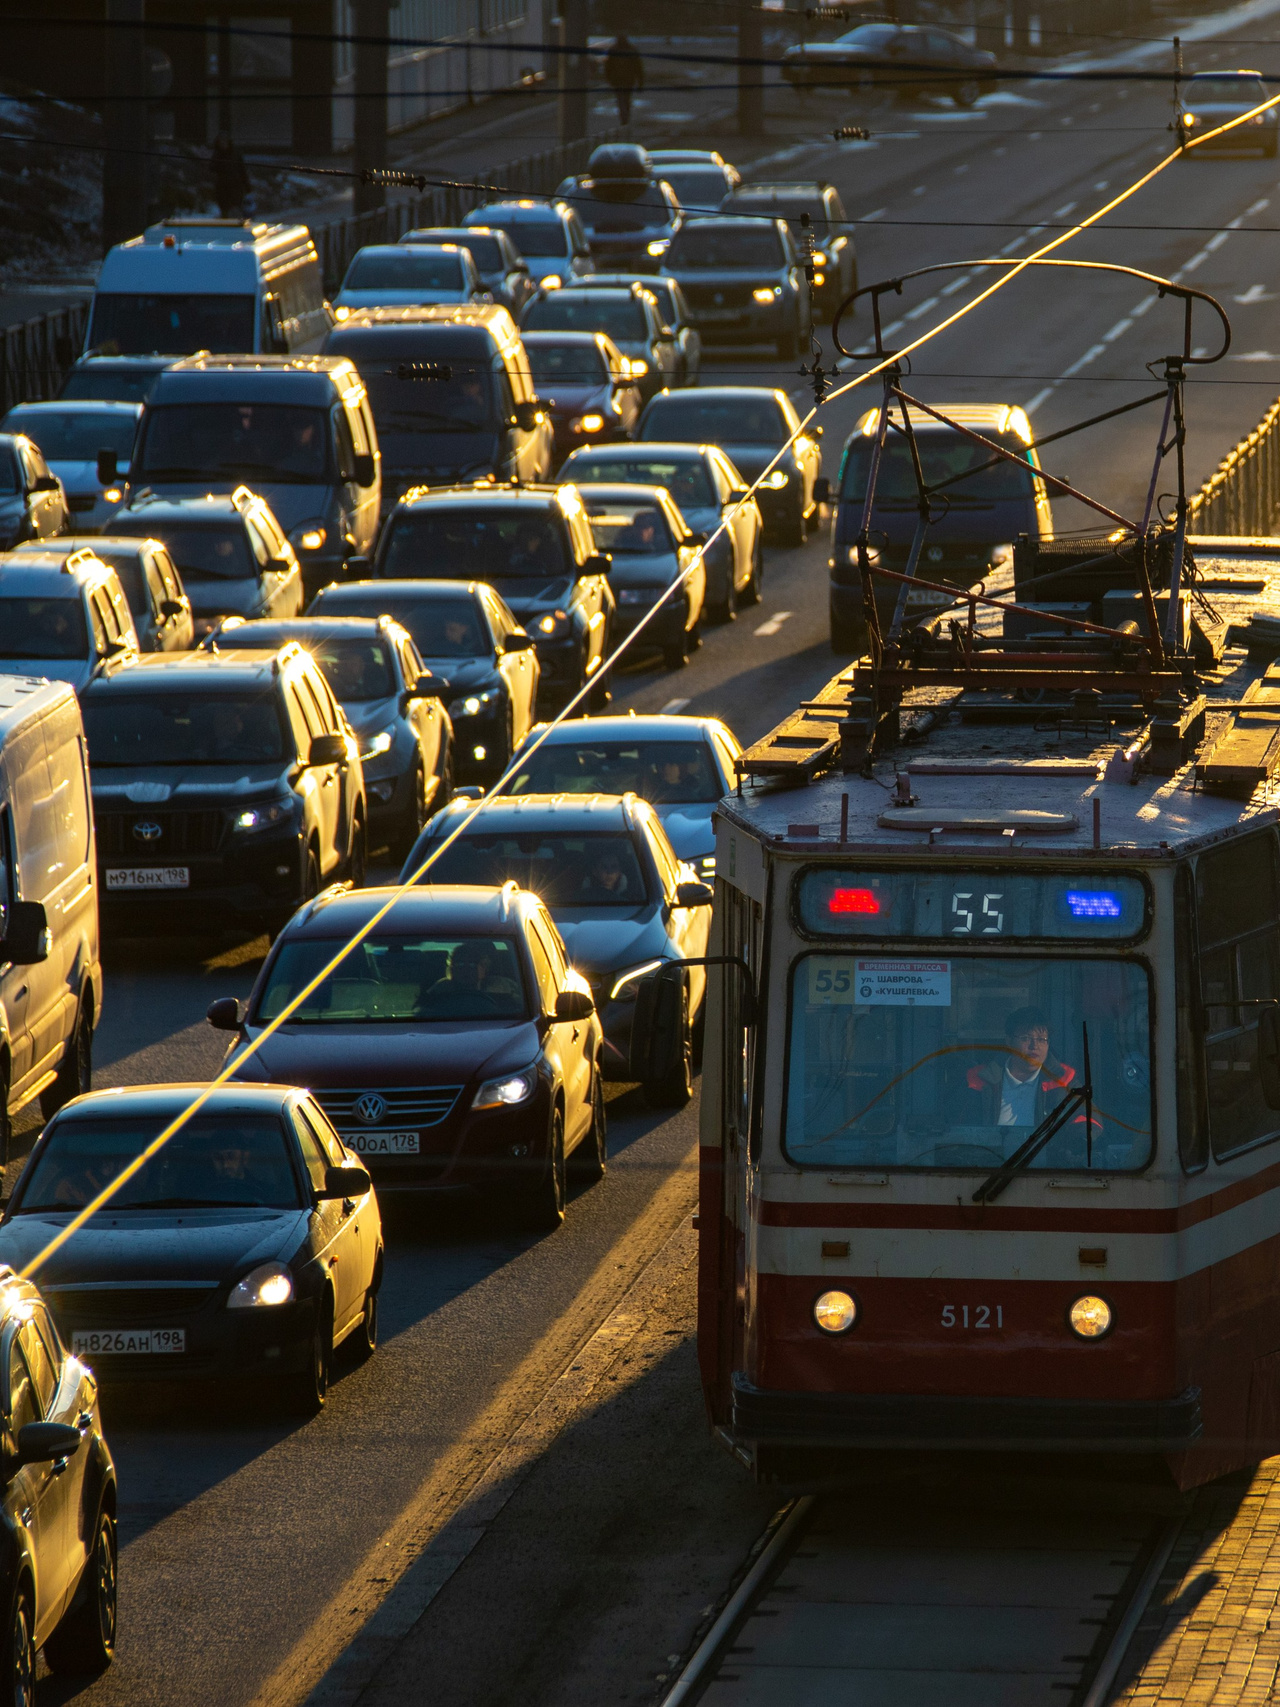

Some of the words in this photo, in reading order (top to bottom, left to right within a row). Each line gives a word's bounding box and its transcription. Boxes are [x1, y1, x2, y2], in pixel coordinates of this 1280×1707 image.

[109, 871, 163, 885] М916НХ
[166, 869, 185, 879] 198
[951, 892, 1004, 932] 55
[863, 963, 911, 971] ВРЕМЕННАЯ
[815, 969, 851, 993] 55
[875, 988, 940, 996] «КУШЕЛЕВКА»
[341, 1135, 388, 1151] 60ОА
[391, 1134, 415, 1147] 178
[940, 1305, 1003, 1328] 5121
[78, 1334, 149, 1351] Н826АН
[153, 1331, 181, 1345] 198
